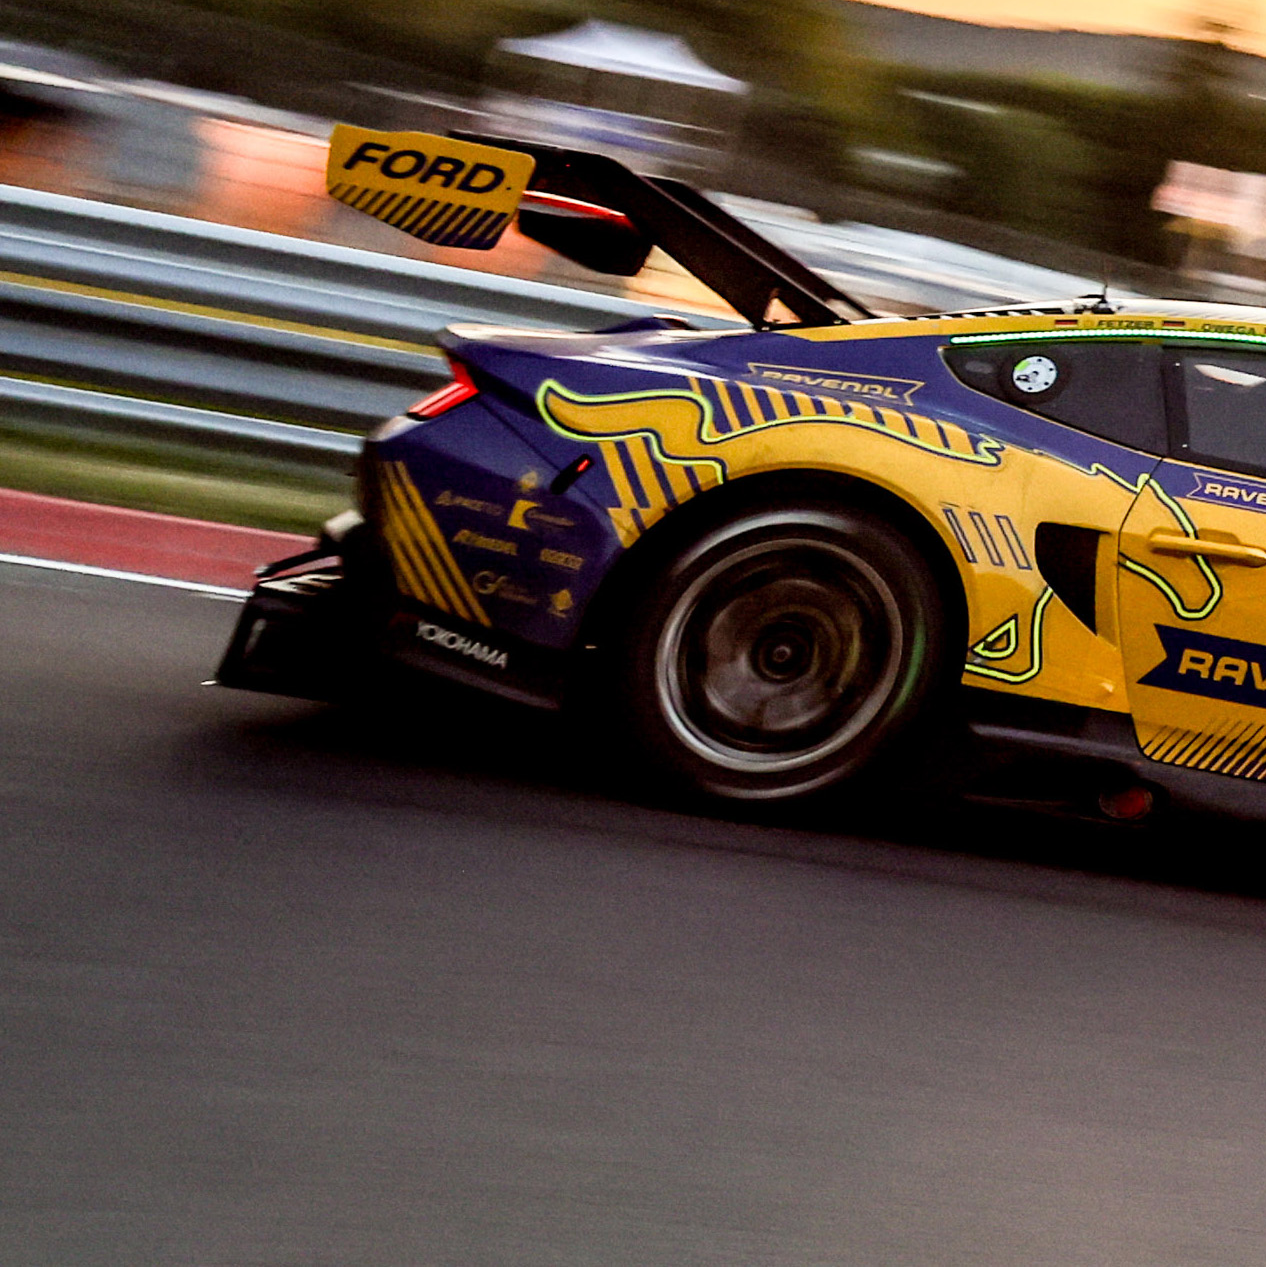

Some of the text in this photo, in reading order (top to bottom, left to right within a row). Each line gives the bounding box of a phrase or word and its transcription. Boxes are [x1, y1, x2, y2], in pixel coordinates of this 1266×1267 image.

[343, 142, 505, 194] FORD
[762, 371, 899, 399] RAVENOL
[417, 620, 508, 669] YOKOHAMA
